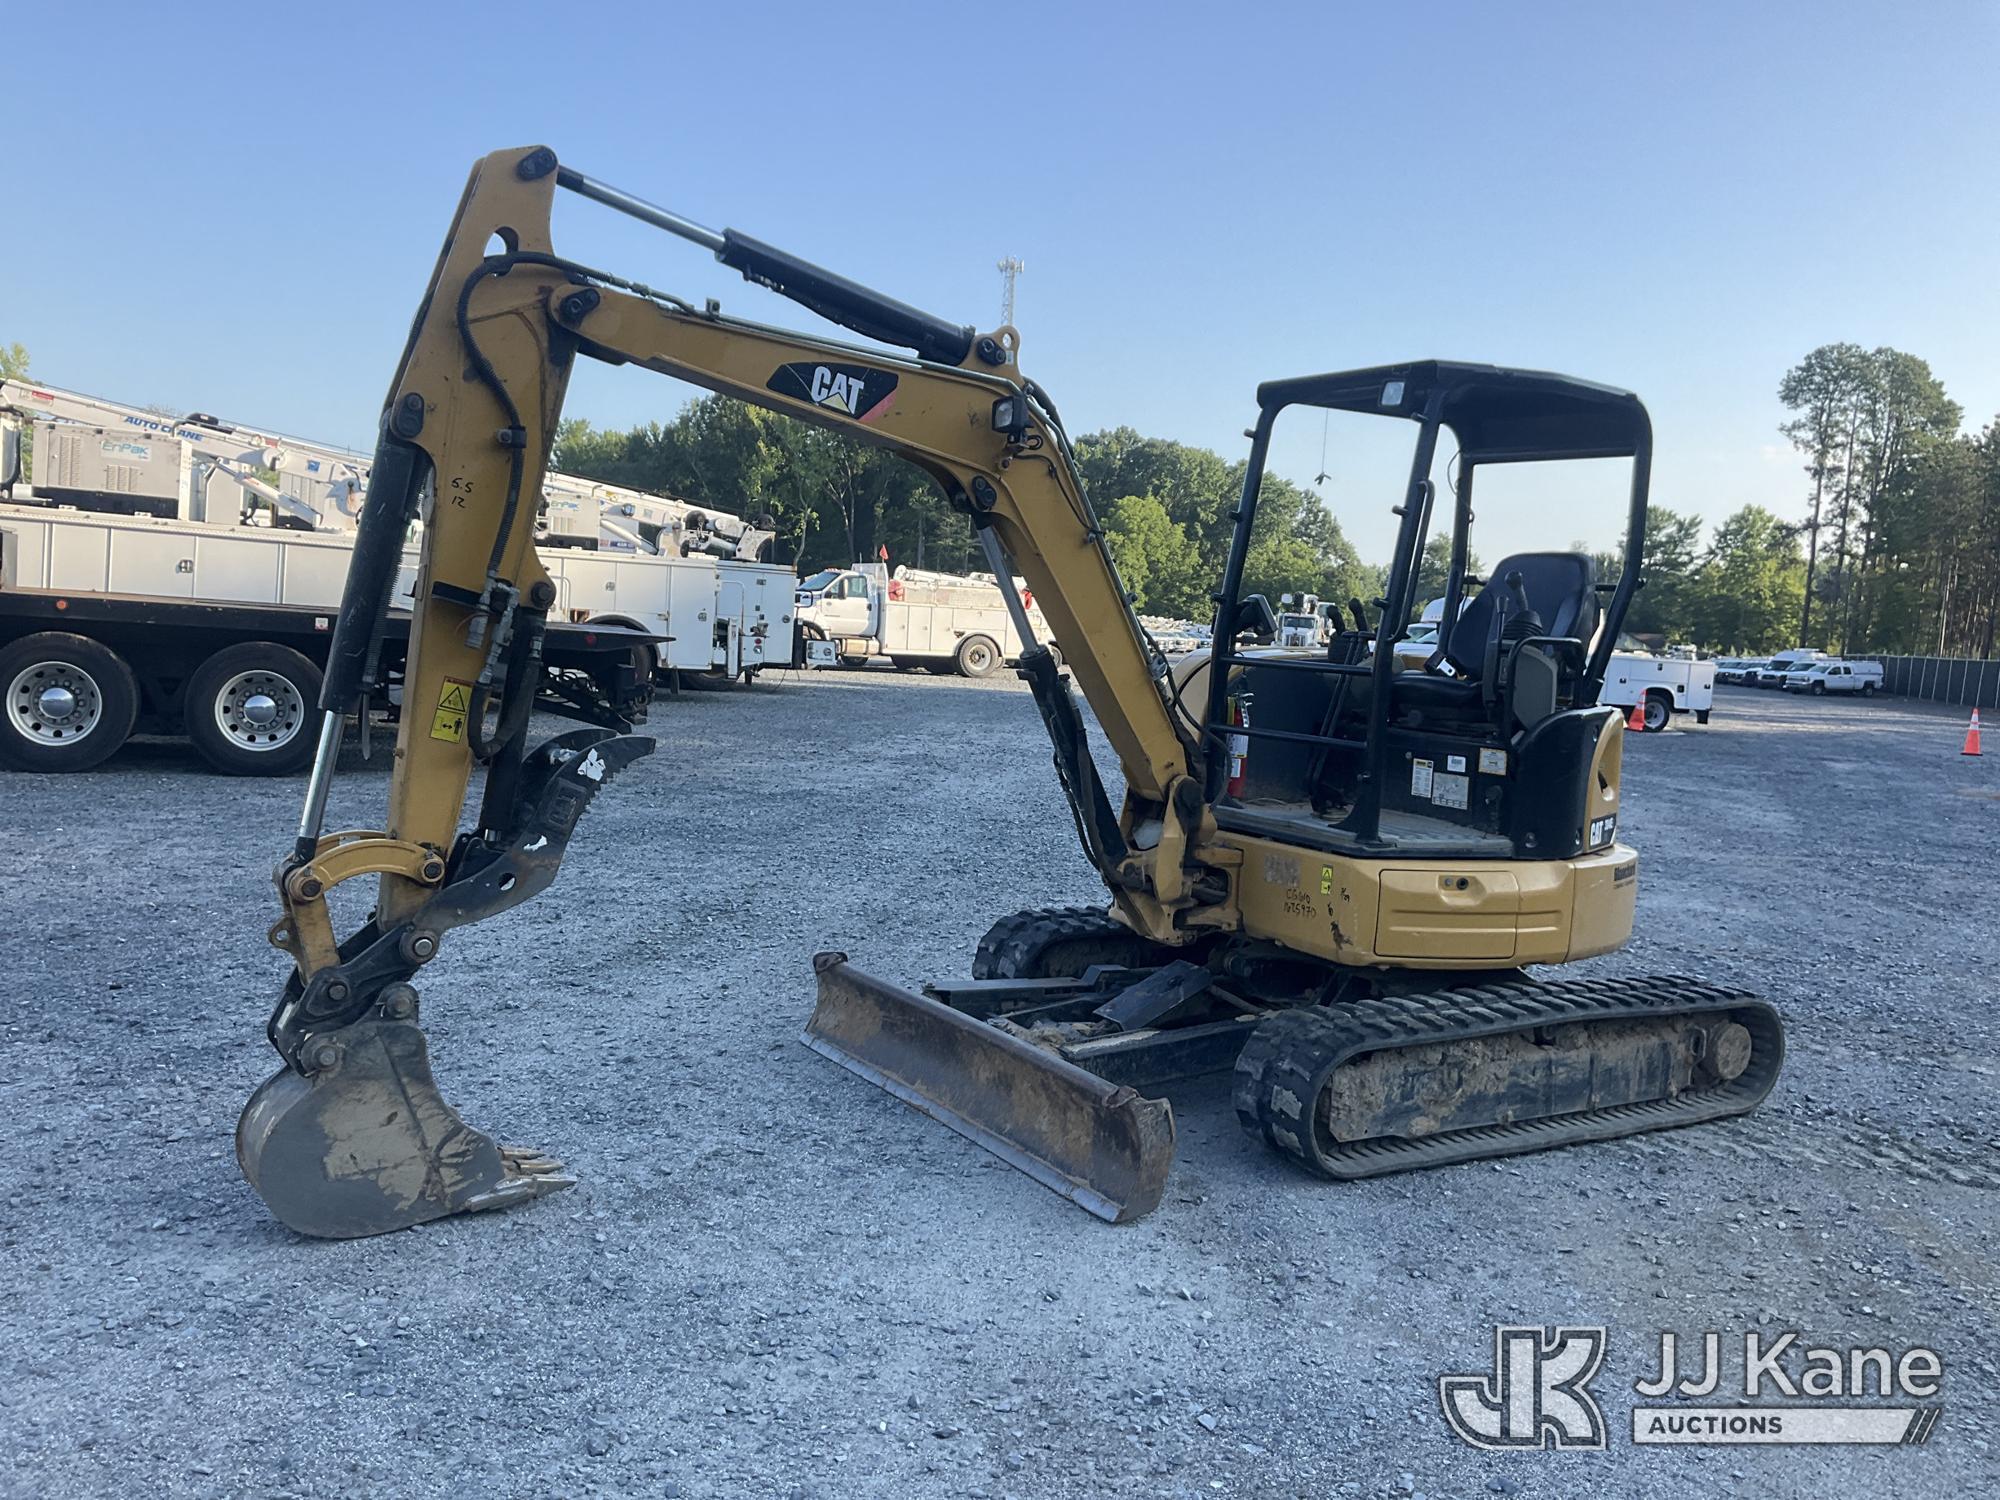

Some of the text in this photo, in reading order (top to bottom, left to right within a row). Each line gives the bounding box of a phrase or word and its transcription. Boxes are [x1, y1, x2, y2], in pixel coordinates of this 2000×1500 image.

[810, 365, 865, 415] CAT
[124, 415, 205, 442] AUTO CANE
[101, 440, 149, 455] EnPak
[451, 496, 466, 509] 12
[1590, 820, 1604, 846] CAT
